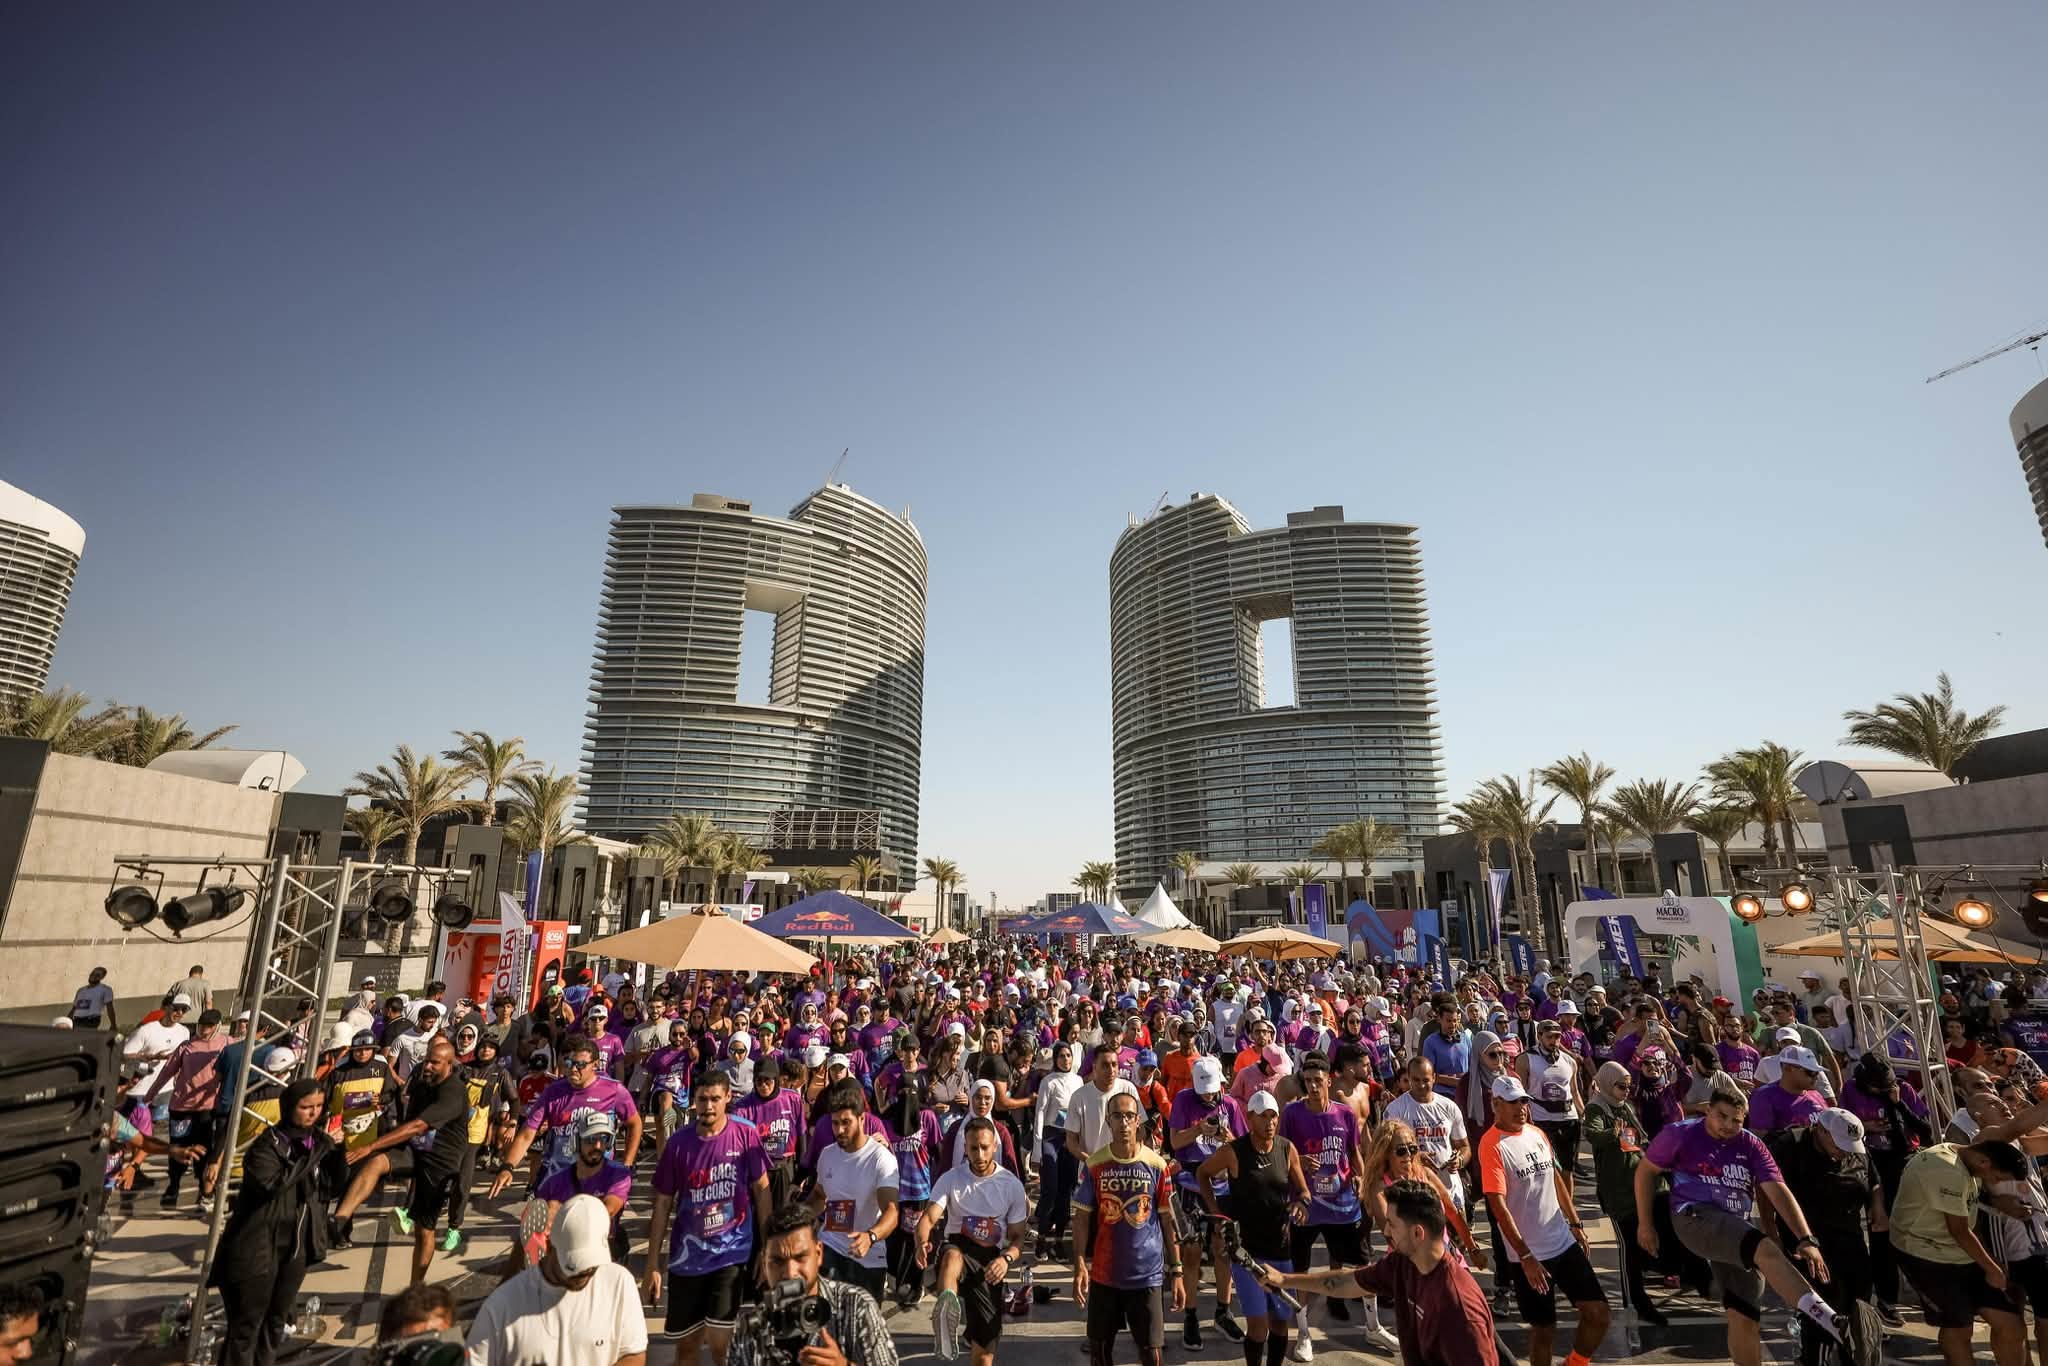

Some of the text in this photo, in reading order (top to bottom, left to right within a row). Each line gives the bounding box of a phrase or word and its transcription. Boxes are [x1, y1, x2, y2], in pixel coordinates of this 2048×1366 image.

[1656, 907, 1684, 917] MACRO
[785, 922, 855, 931] Red Bull
[1414, 1127, 1448, 1138] RUN
[1526, 1151, 1538, 1163] FIT
[710, 1163, 737, 1183] RACE
[1132, 1168, 1151, 1179] Ultra
[1516, 1161, 1553, 1179] MASTERS
[1698, 1174, 1720, 1185] THE
[1100, 1178, 1151, 1193] EGYPT
[690, 1182, 737, 1203] THE COAST
